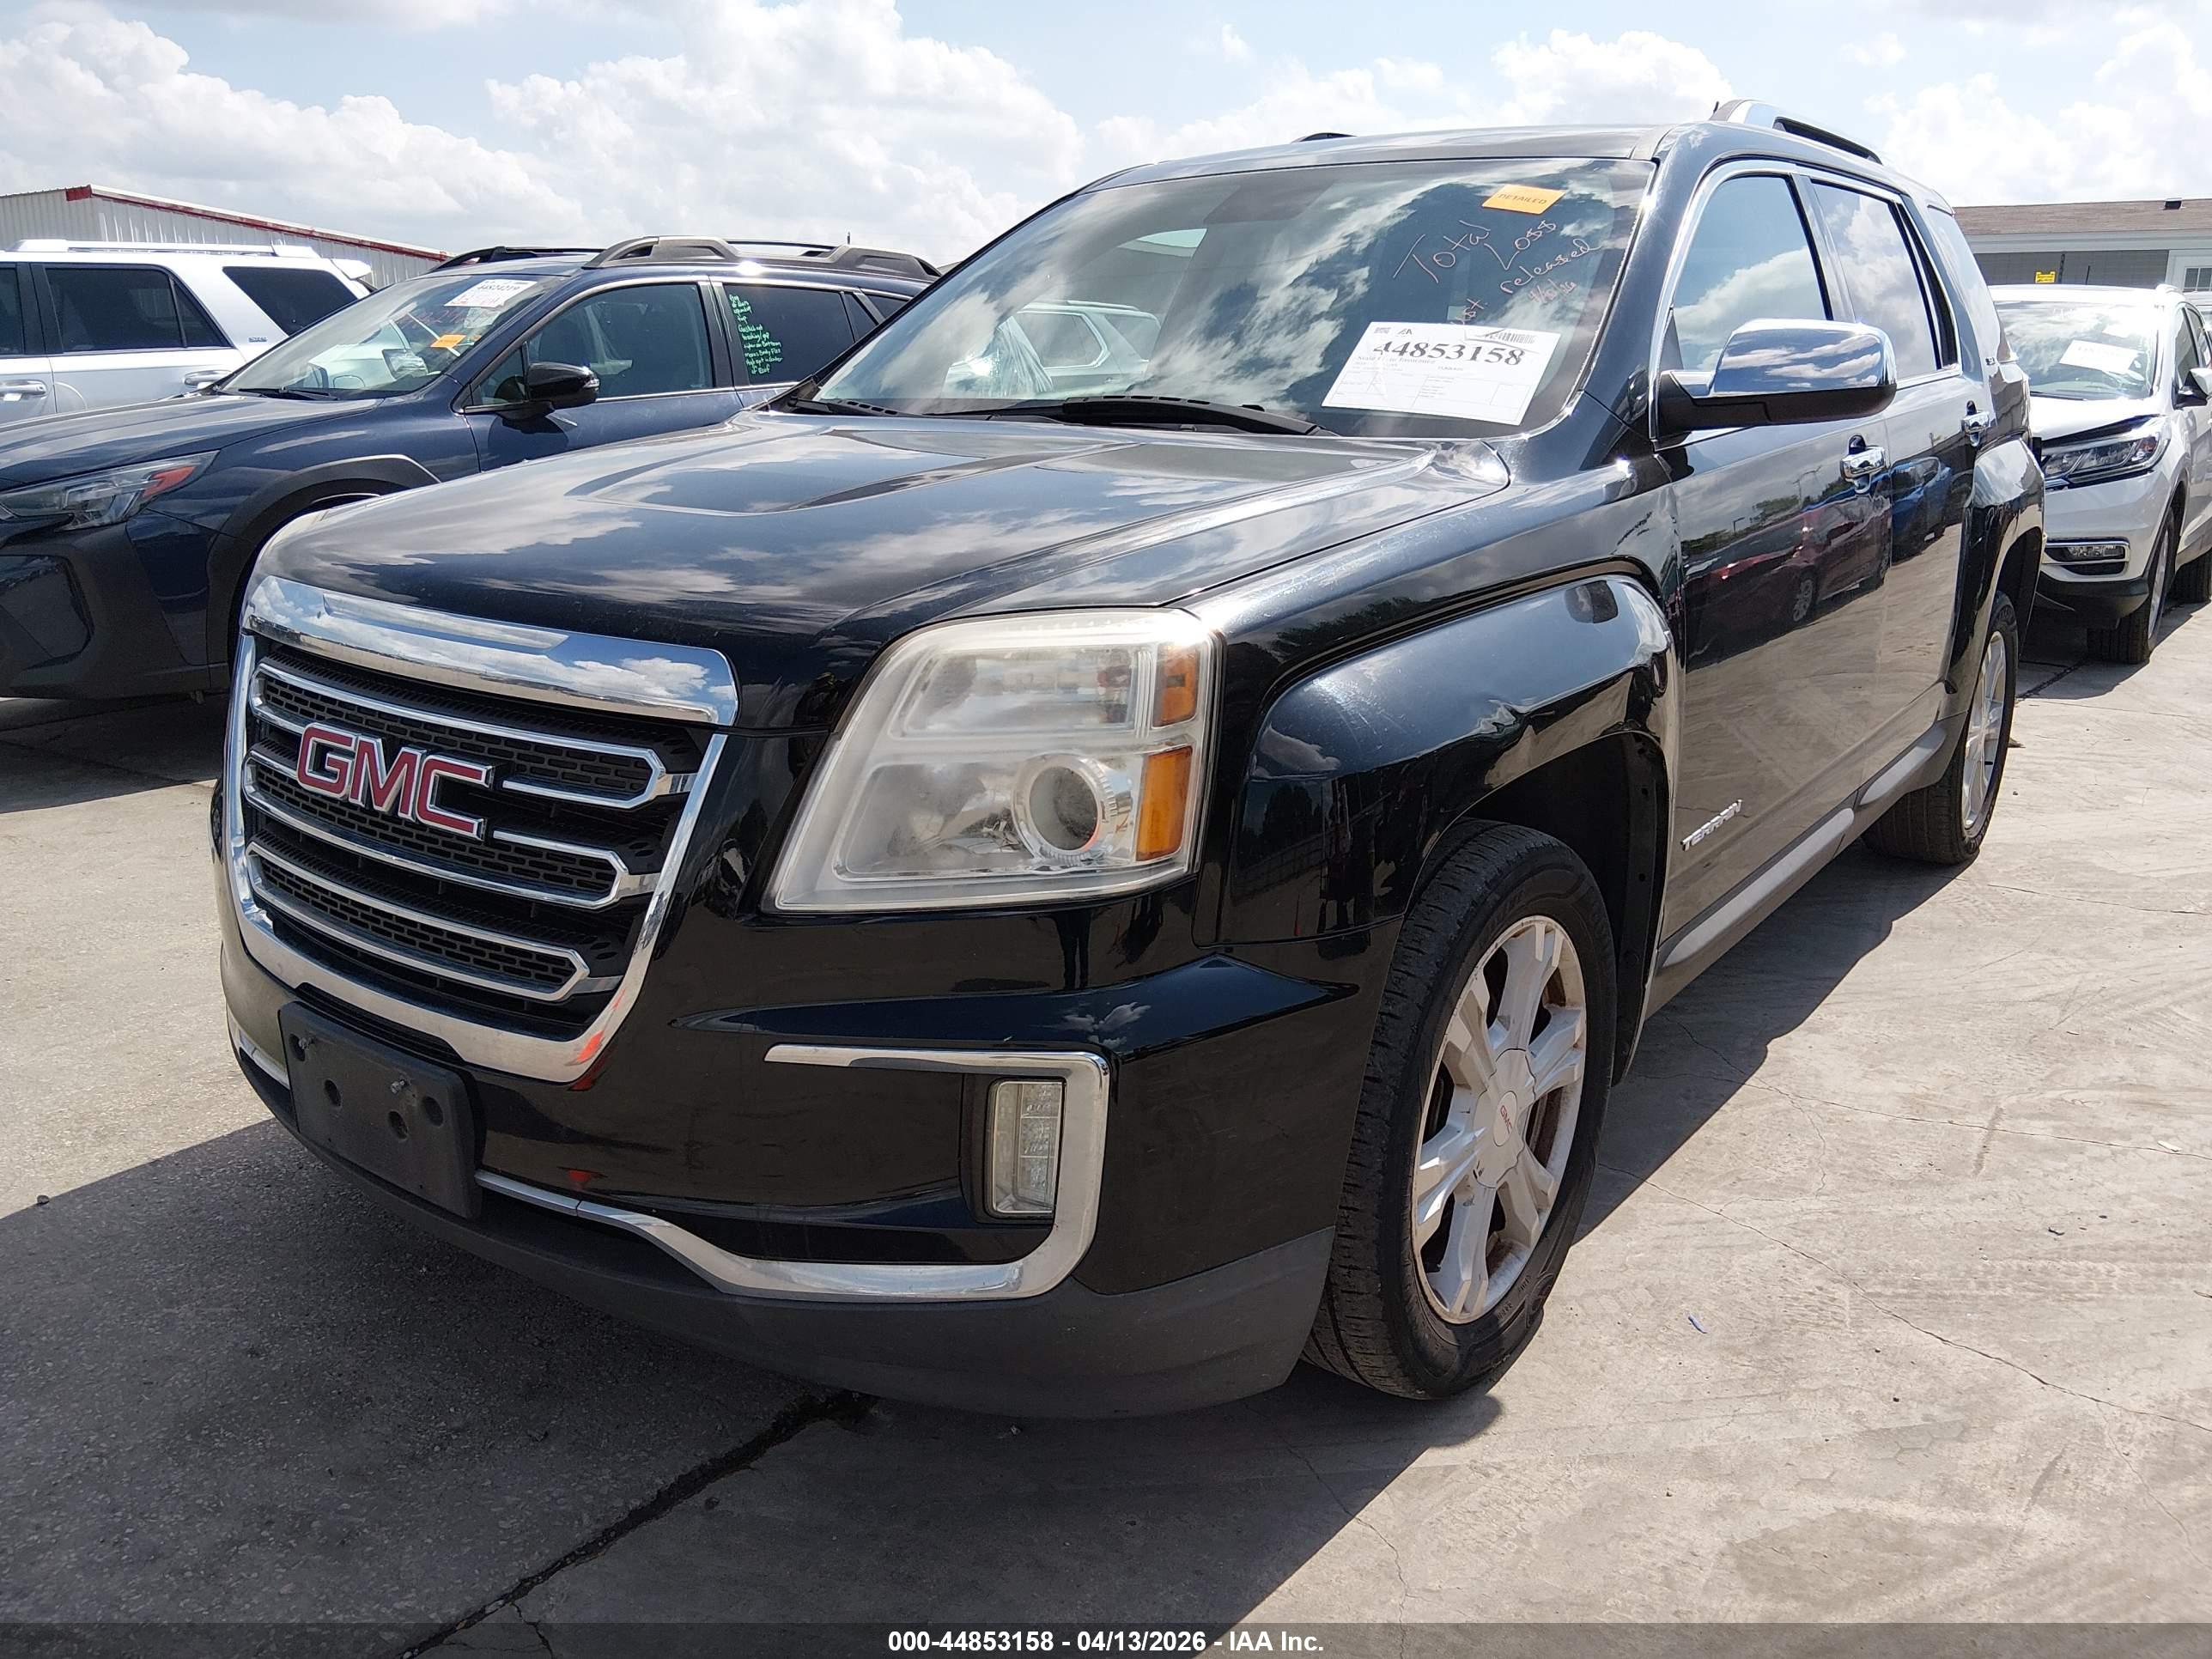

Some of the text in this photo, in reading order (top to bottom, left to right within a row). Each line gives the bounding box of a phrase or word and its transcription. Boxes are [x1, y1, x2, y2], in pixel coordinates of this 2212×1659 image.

[1498, 193, 1547, 204] DETAILED
[1393, 220, 1492, 283] Total
[1484, 220, 1557, 270] Loss
[1500, 238, 1602, 294] released
[1373, 341, 1526, 366] 44853158
[297, 722, 495, 842] GMC
[1681, 799, 1743, 852] TERRAIN
[1500, 1105, 1512, 1134] GMC
